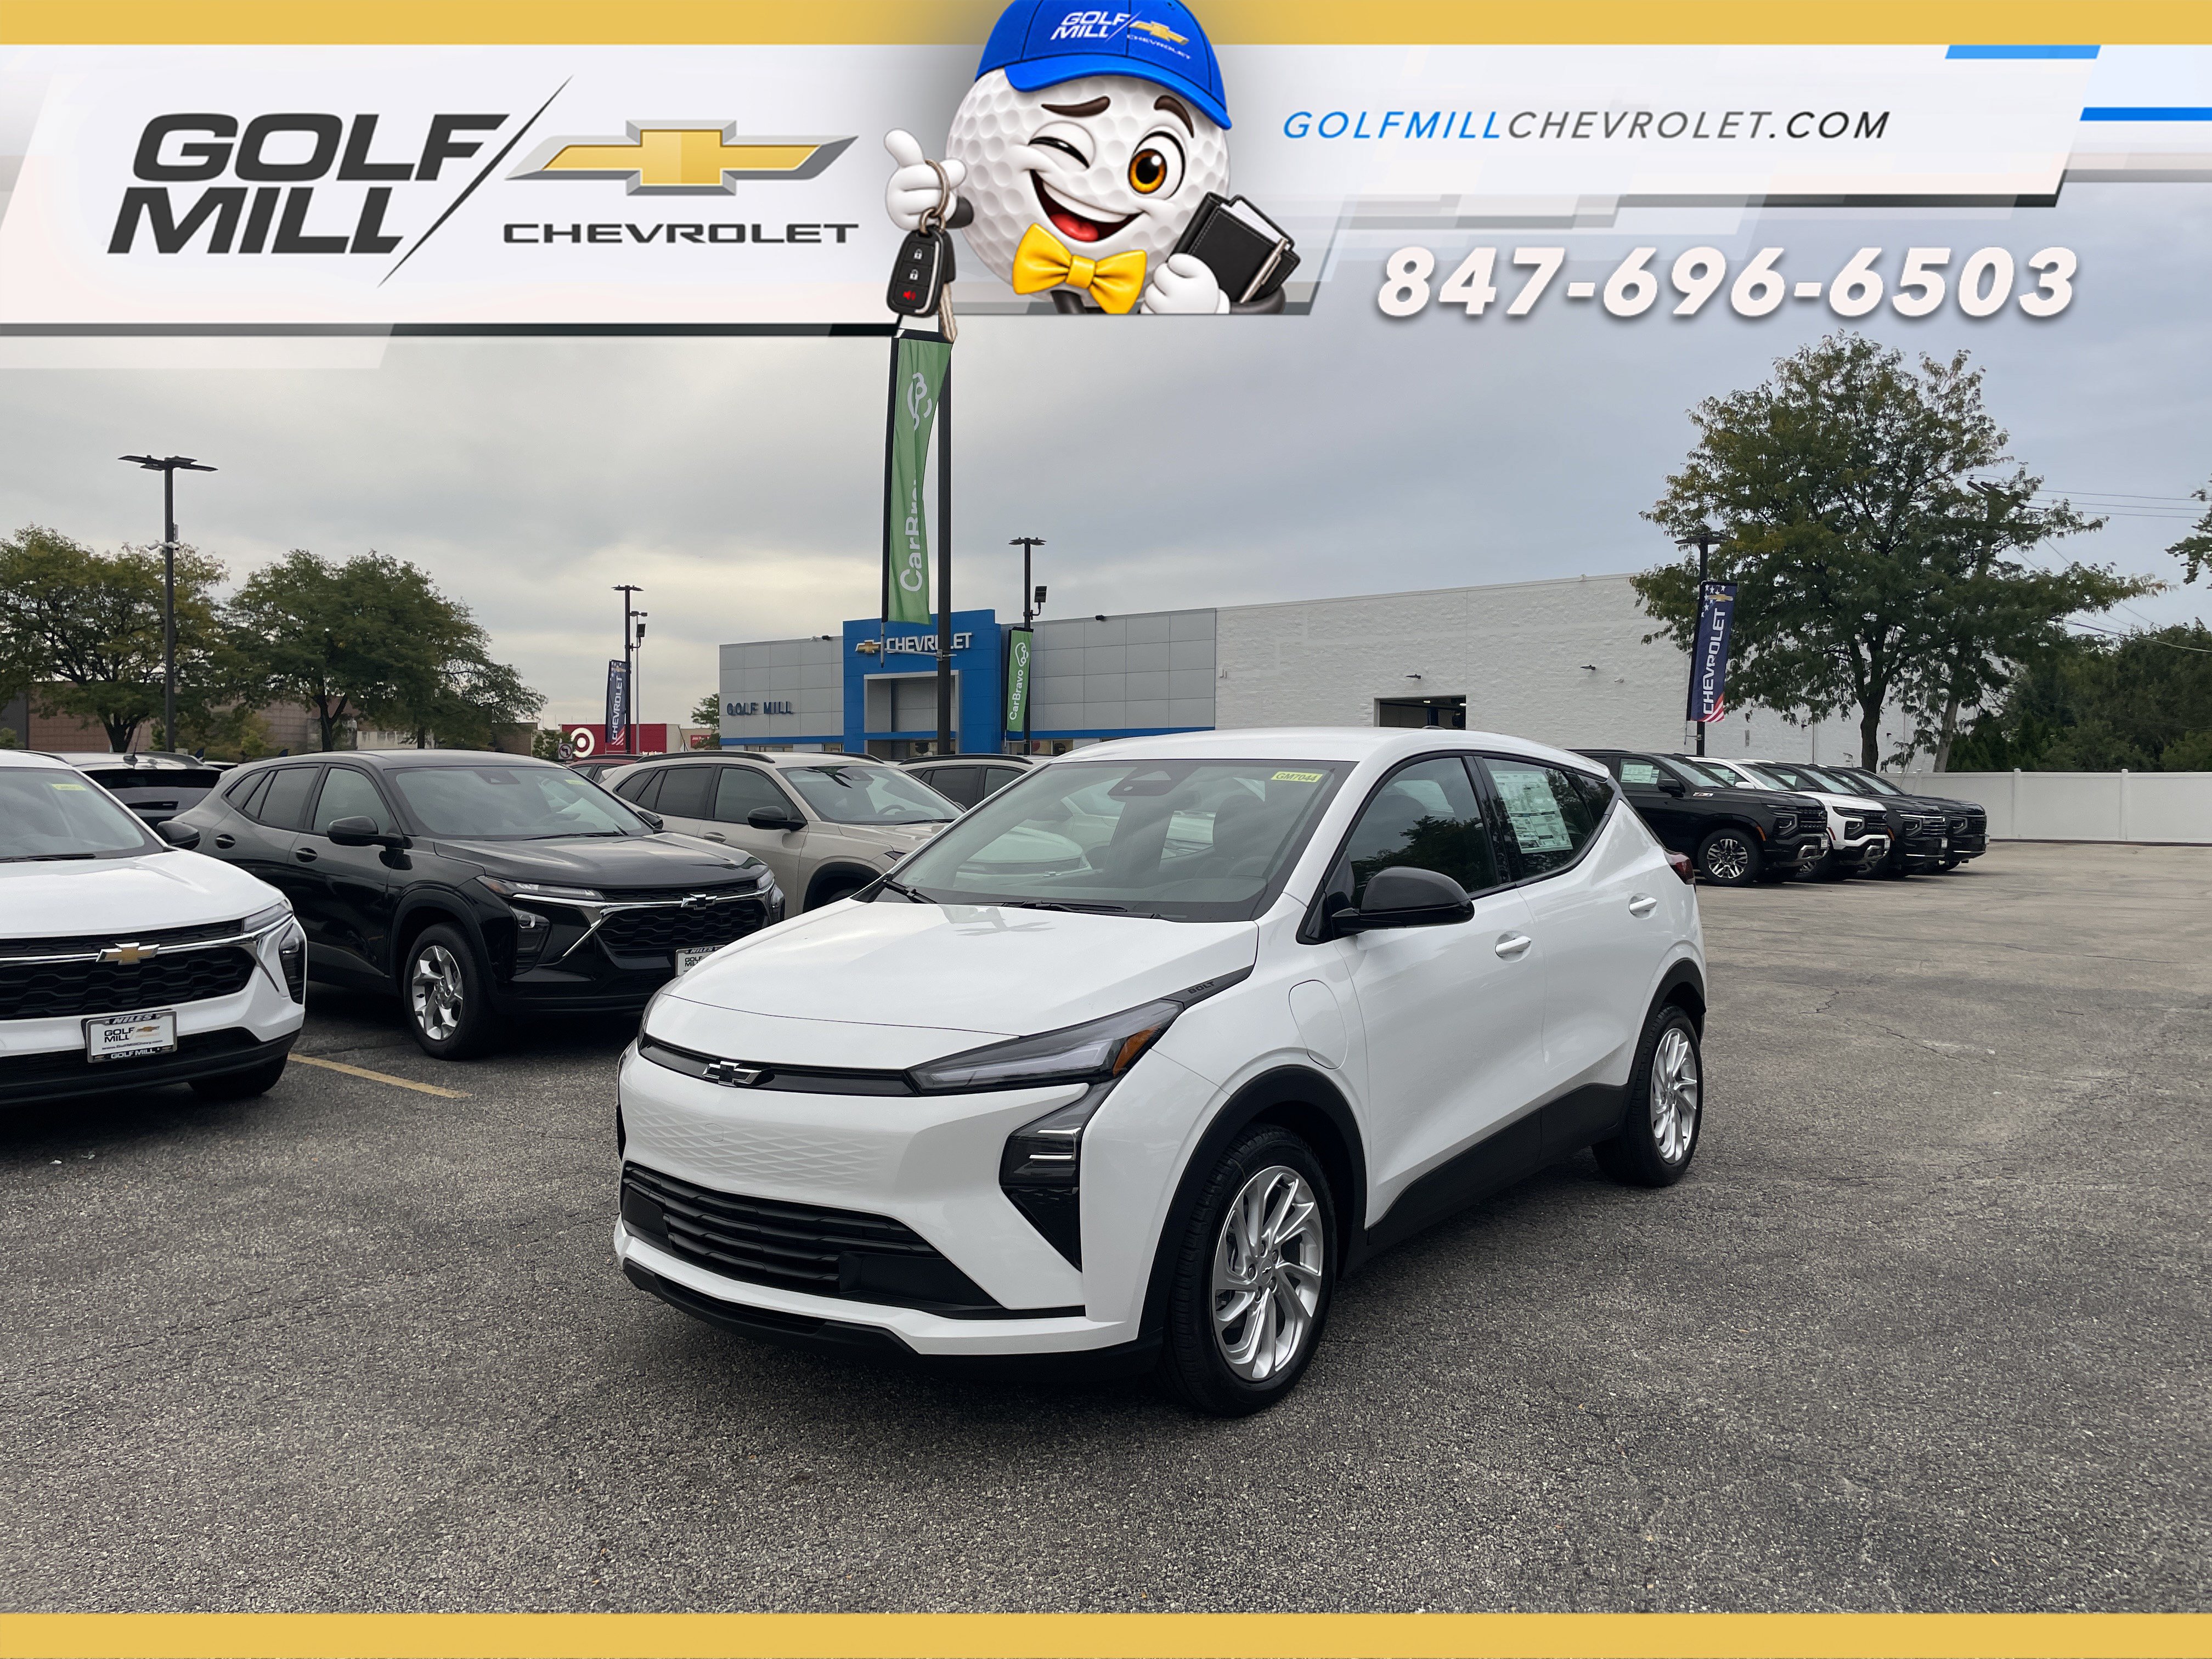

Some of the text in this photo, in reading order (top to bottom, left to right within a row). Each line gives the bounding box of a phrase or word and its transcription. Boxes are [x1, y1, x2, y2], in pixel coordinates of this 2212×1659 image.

[887, 632, 972, 653] CHEVRET
[1702, 608, 1726, 714] CHEVROLET
[1009, 669, 1024, 721] CarBravo
[612, 675, 623, 741] CHEVROLET
[727, 701, 793, 715] GOLF MILL
[1276, 772, 1318, 781] GM7044
[1187, 981, 1215, 994] BOLT
[112, 1013, 154, 1025] NILES
[104, 1026, 136, 1036] GOLF
[104, 1034, 129, 1043] MILL
[111, 1048, 156, 1059] GOLF MILL
